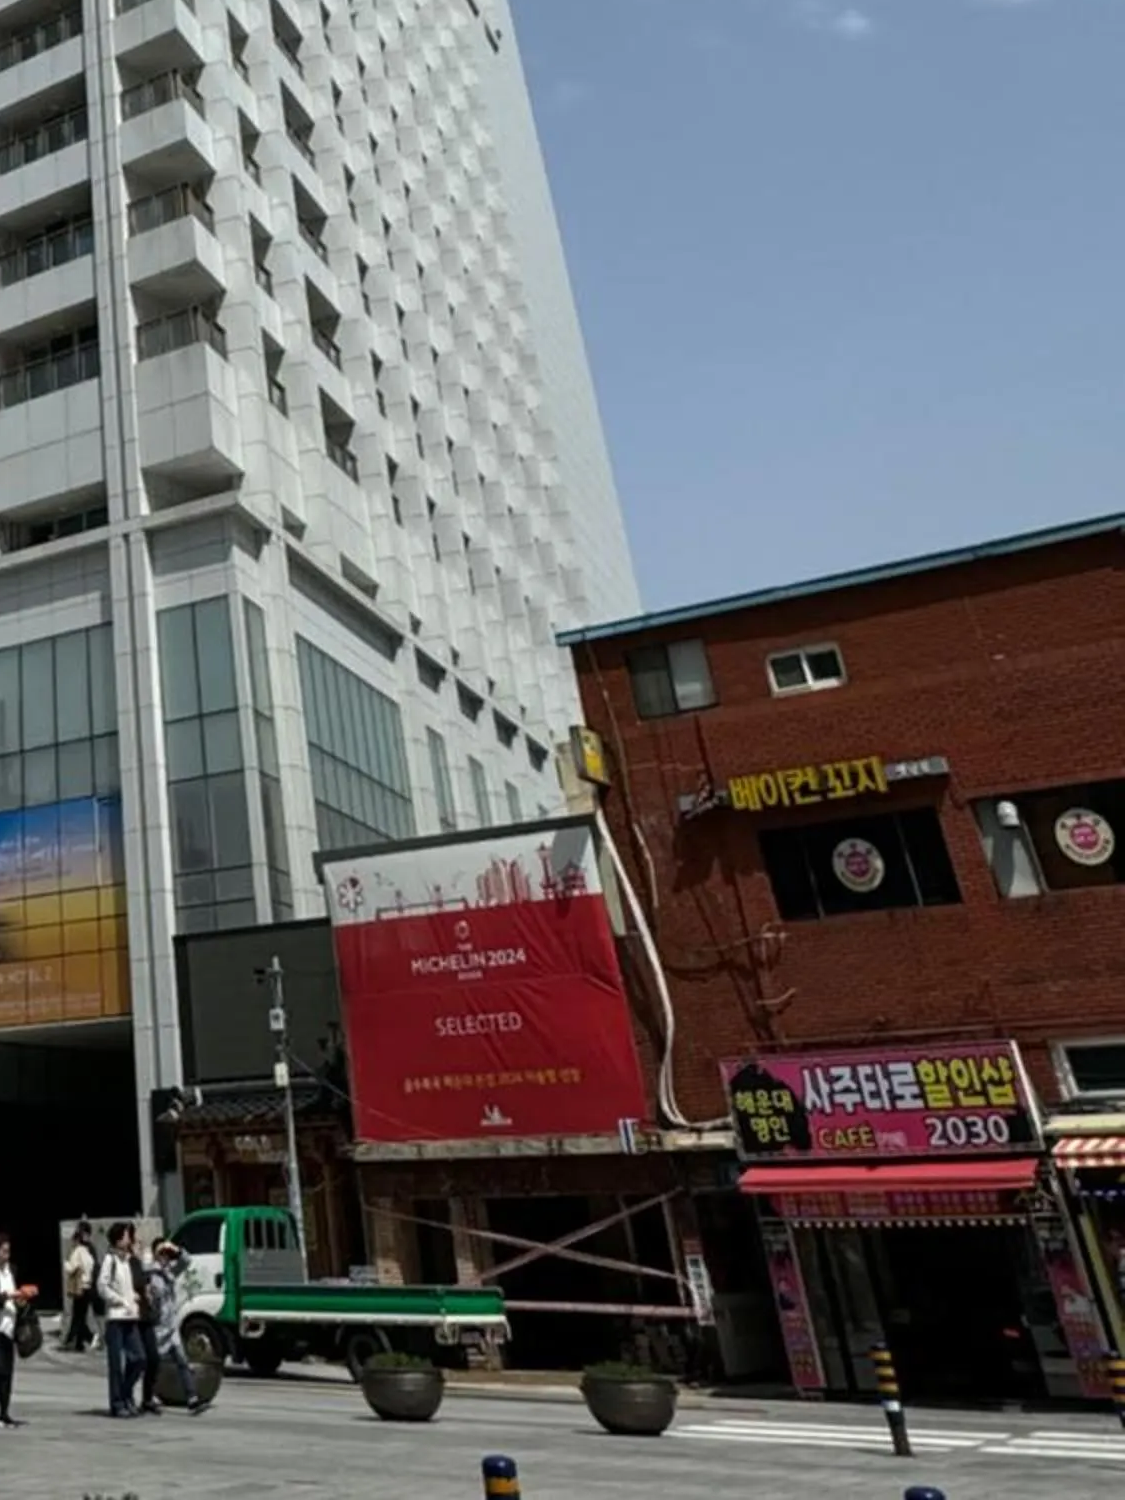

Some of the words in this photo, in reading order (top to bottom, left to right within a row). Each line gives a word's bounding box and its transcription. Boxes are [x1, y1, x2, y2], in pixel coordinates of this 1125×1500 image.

[411, 950, 487, 976] MICHELIN
[488, 947, 527, 967] 2024
[434, 1011, 523, 1038] SELECTED
[818, 1124, 875, 1149] CAFE
[925, 1114, 1010, 1147] 2030
